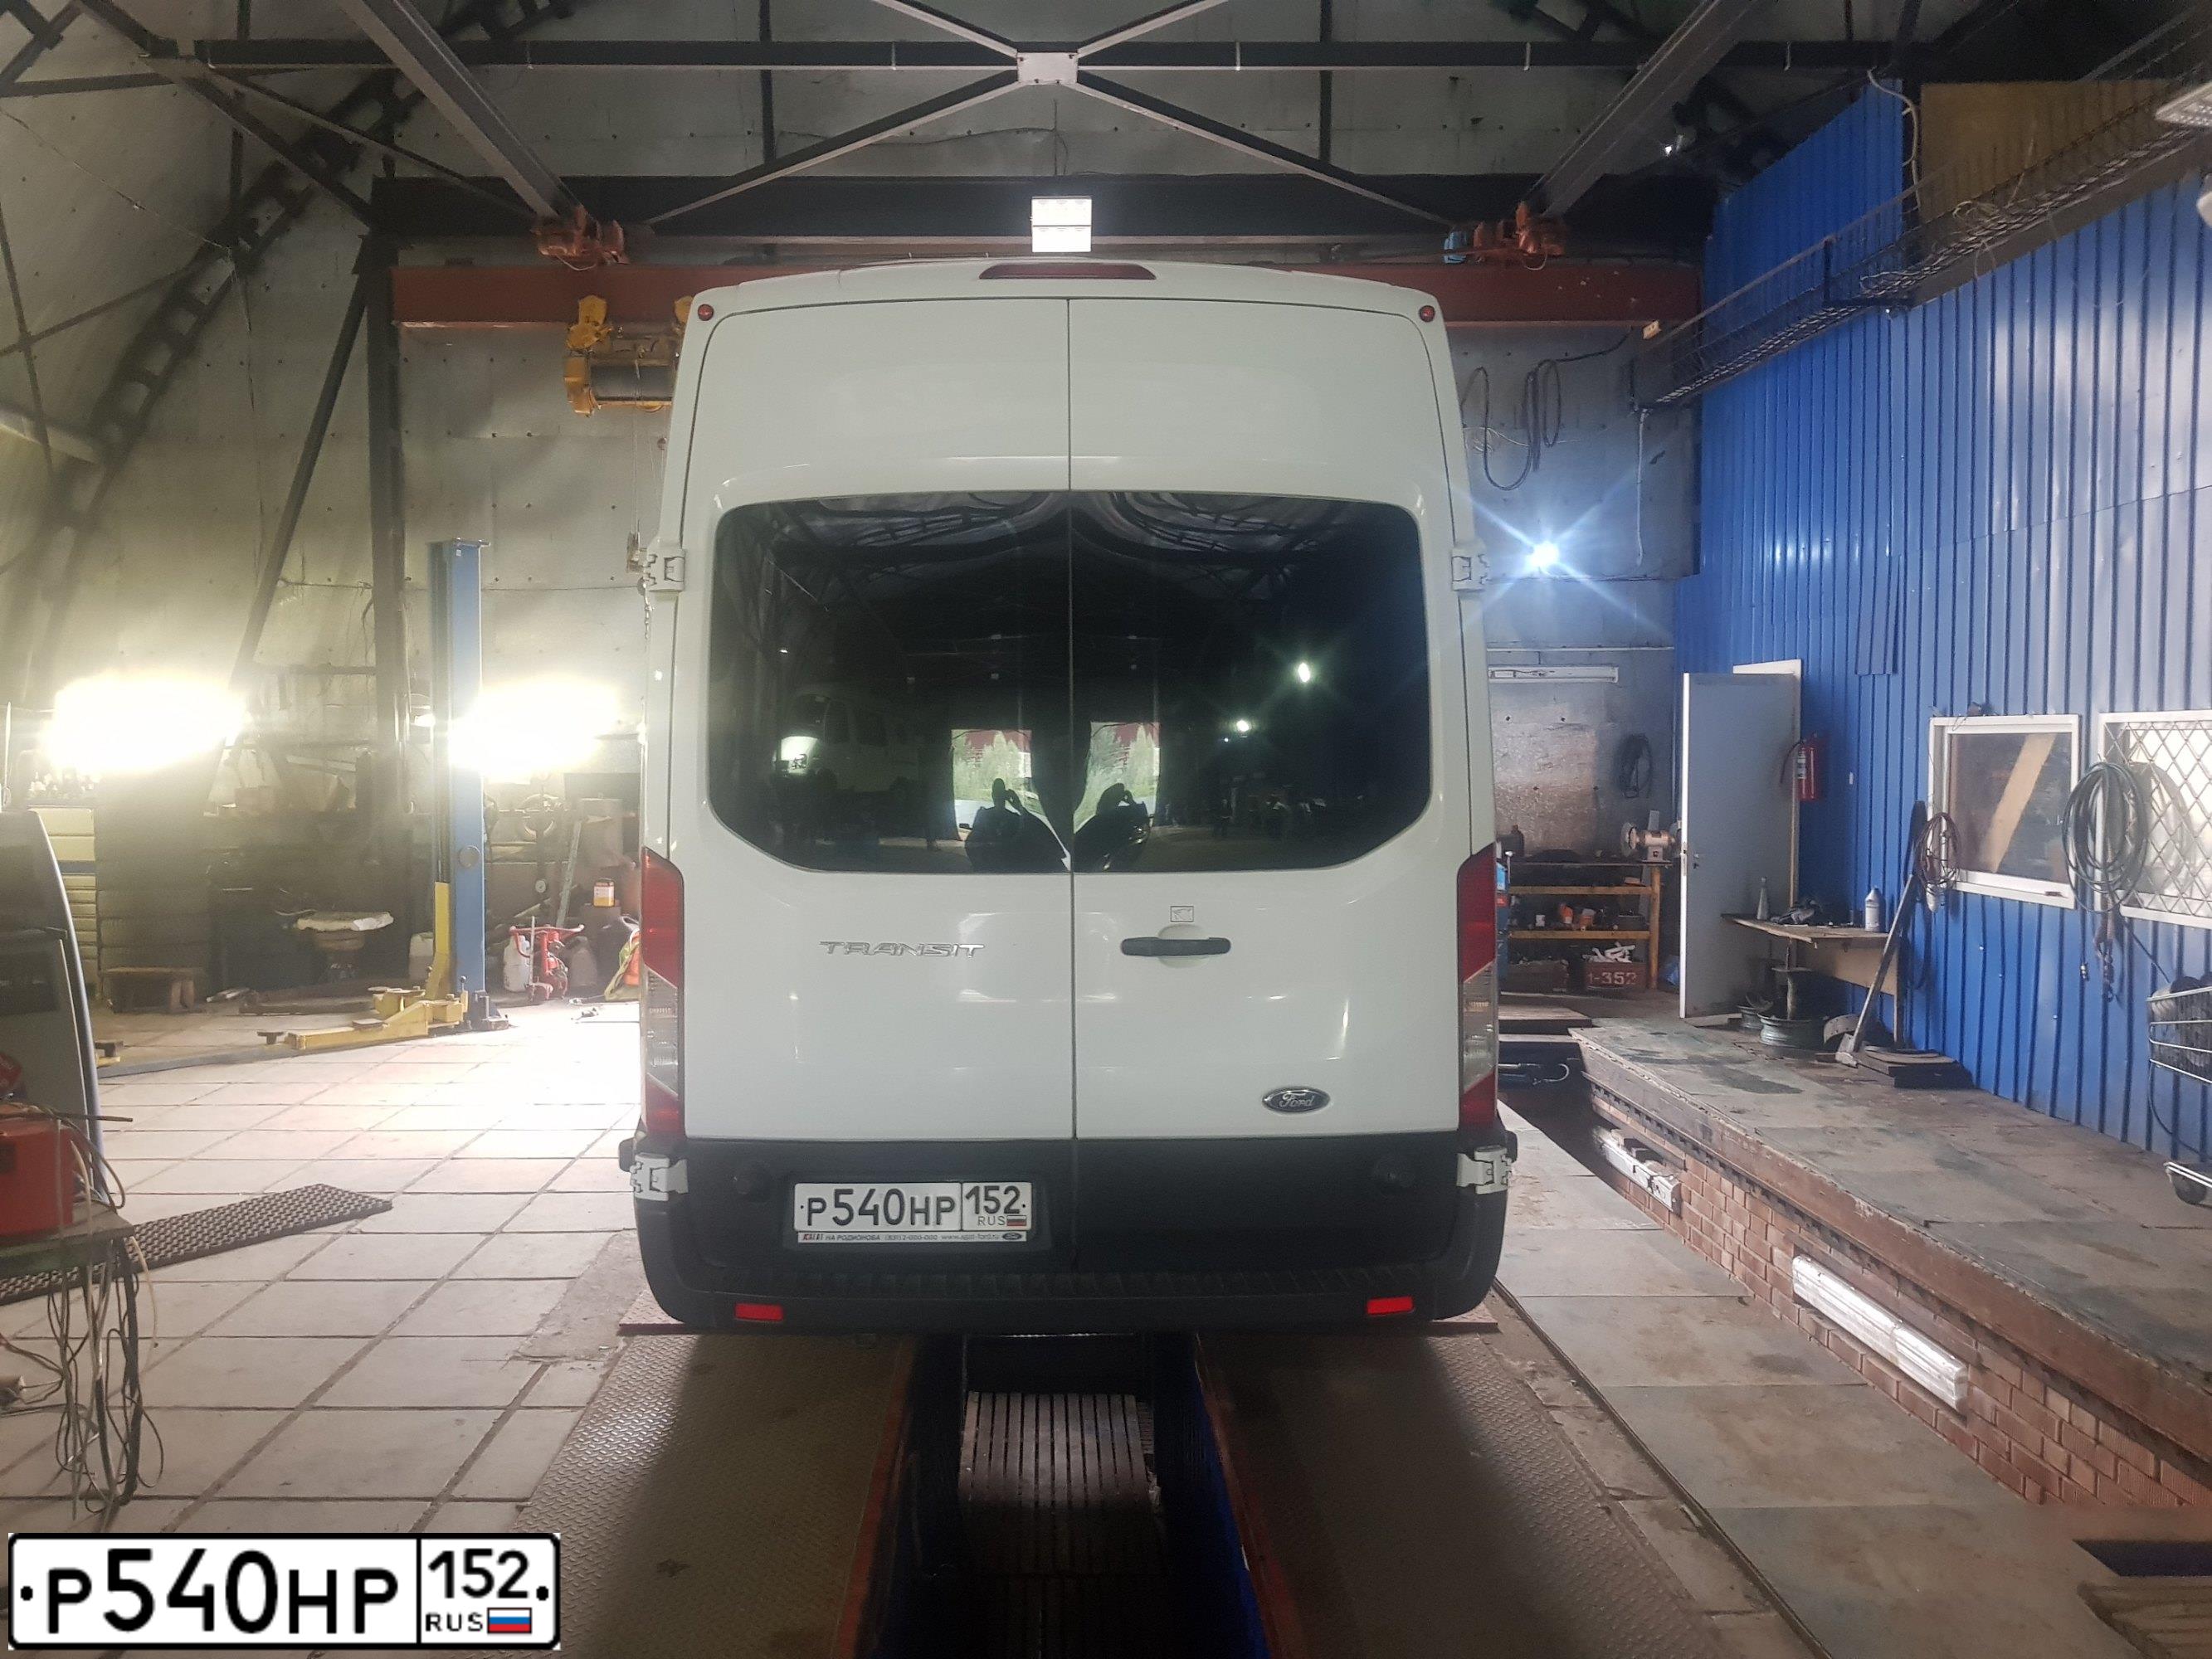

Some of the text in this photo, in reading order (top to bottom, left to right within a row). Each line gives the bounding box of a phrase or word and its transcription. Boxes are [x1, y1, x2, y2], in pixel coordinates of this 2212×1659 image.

[819, 941, 985, 957] TRANSIT
[1279, 1092, 1314, 1107] Ford
[806, 1185, 1021, 1227] Р540НР 152
[977, 1215, 1006, 1226] RUS
